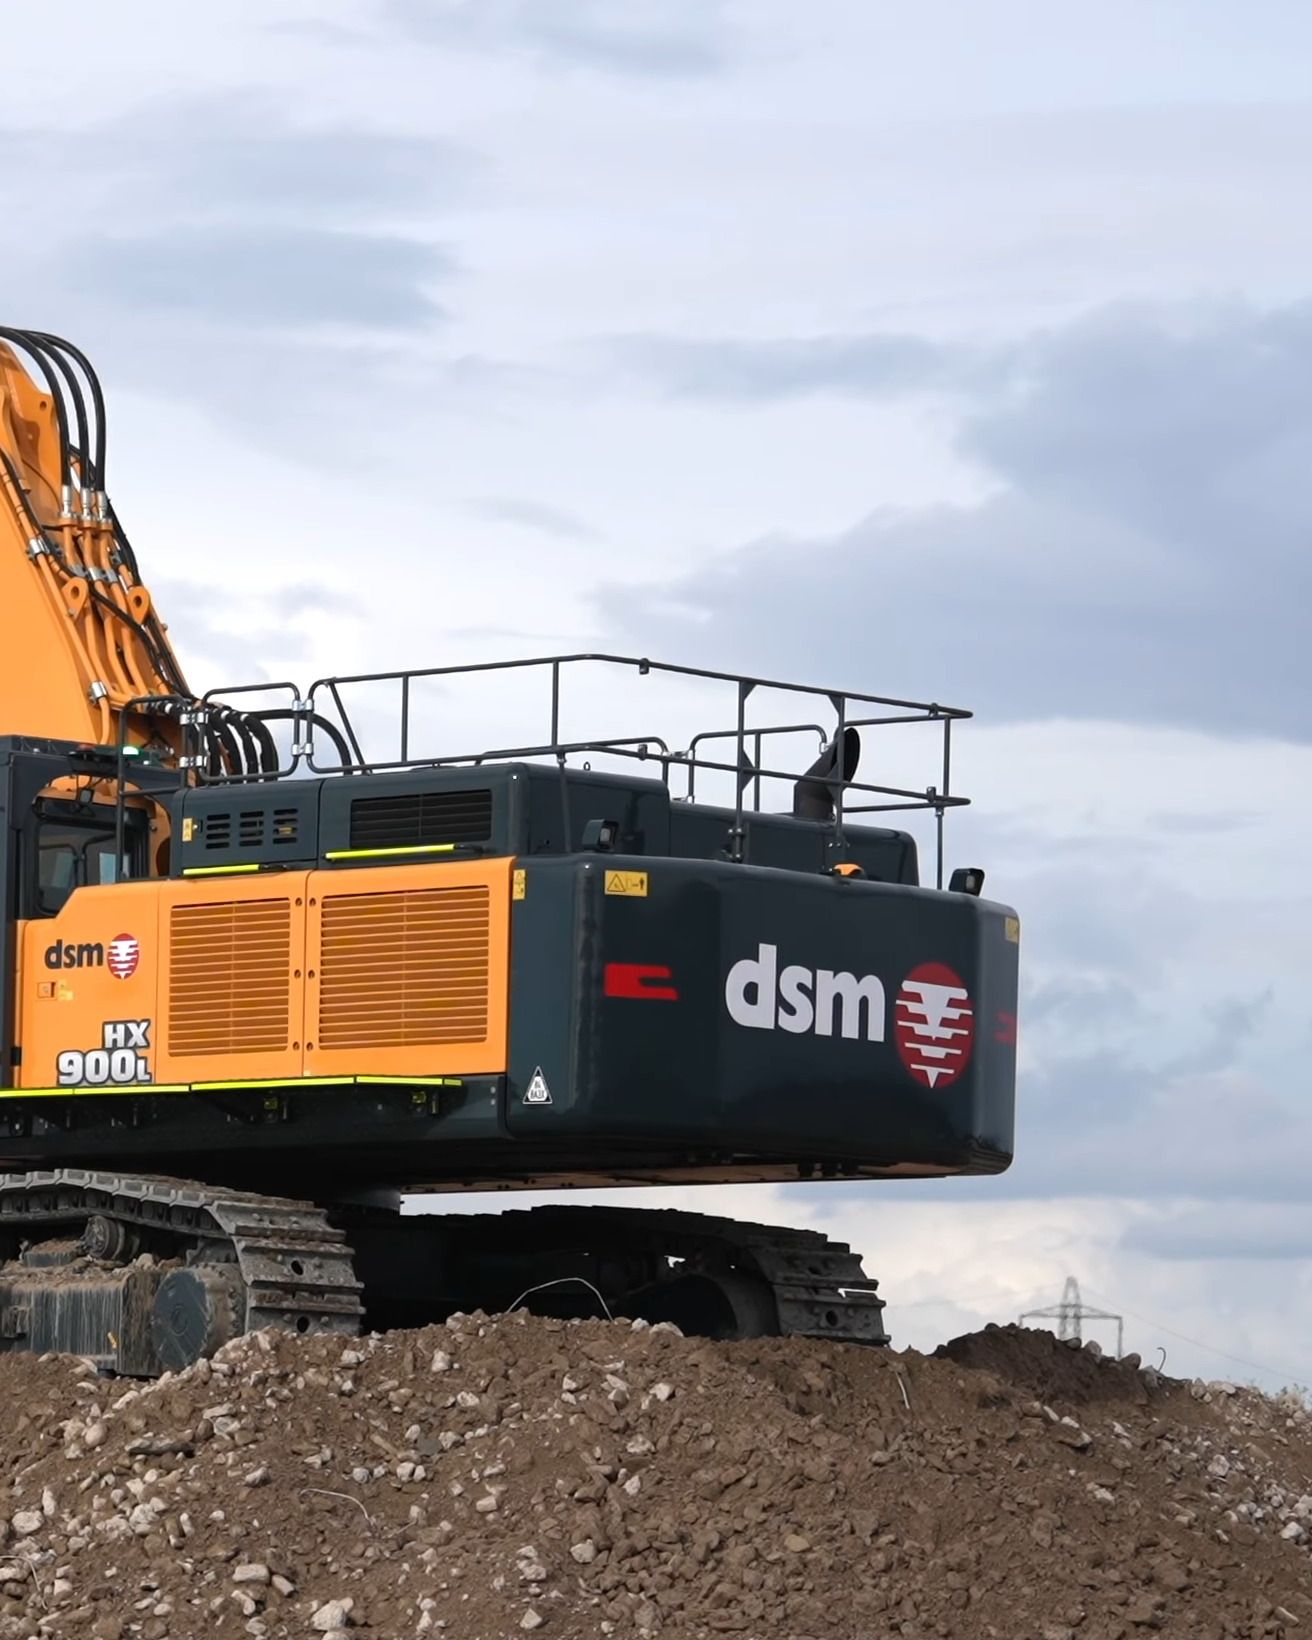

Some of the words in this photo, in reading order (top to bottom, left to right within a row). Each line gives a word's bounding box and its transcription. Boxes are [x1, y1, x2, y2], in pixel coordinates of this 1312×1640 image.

[44, 939, 104, 970] dsm
[725, 943, 886, 1042] dsm
[103, 1020, 150, 1049] HX
[57, 1049, 151, 1086] 900L
